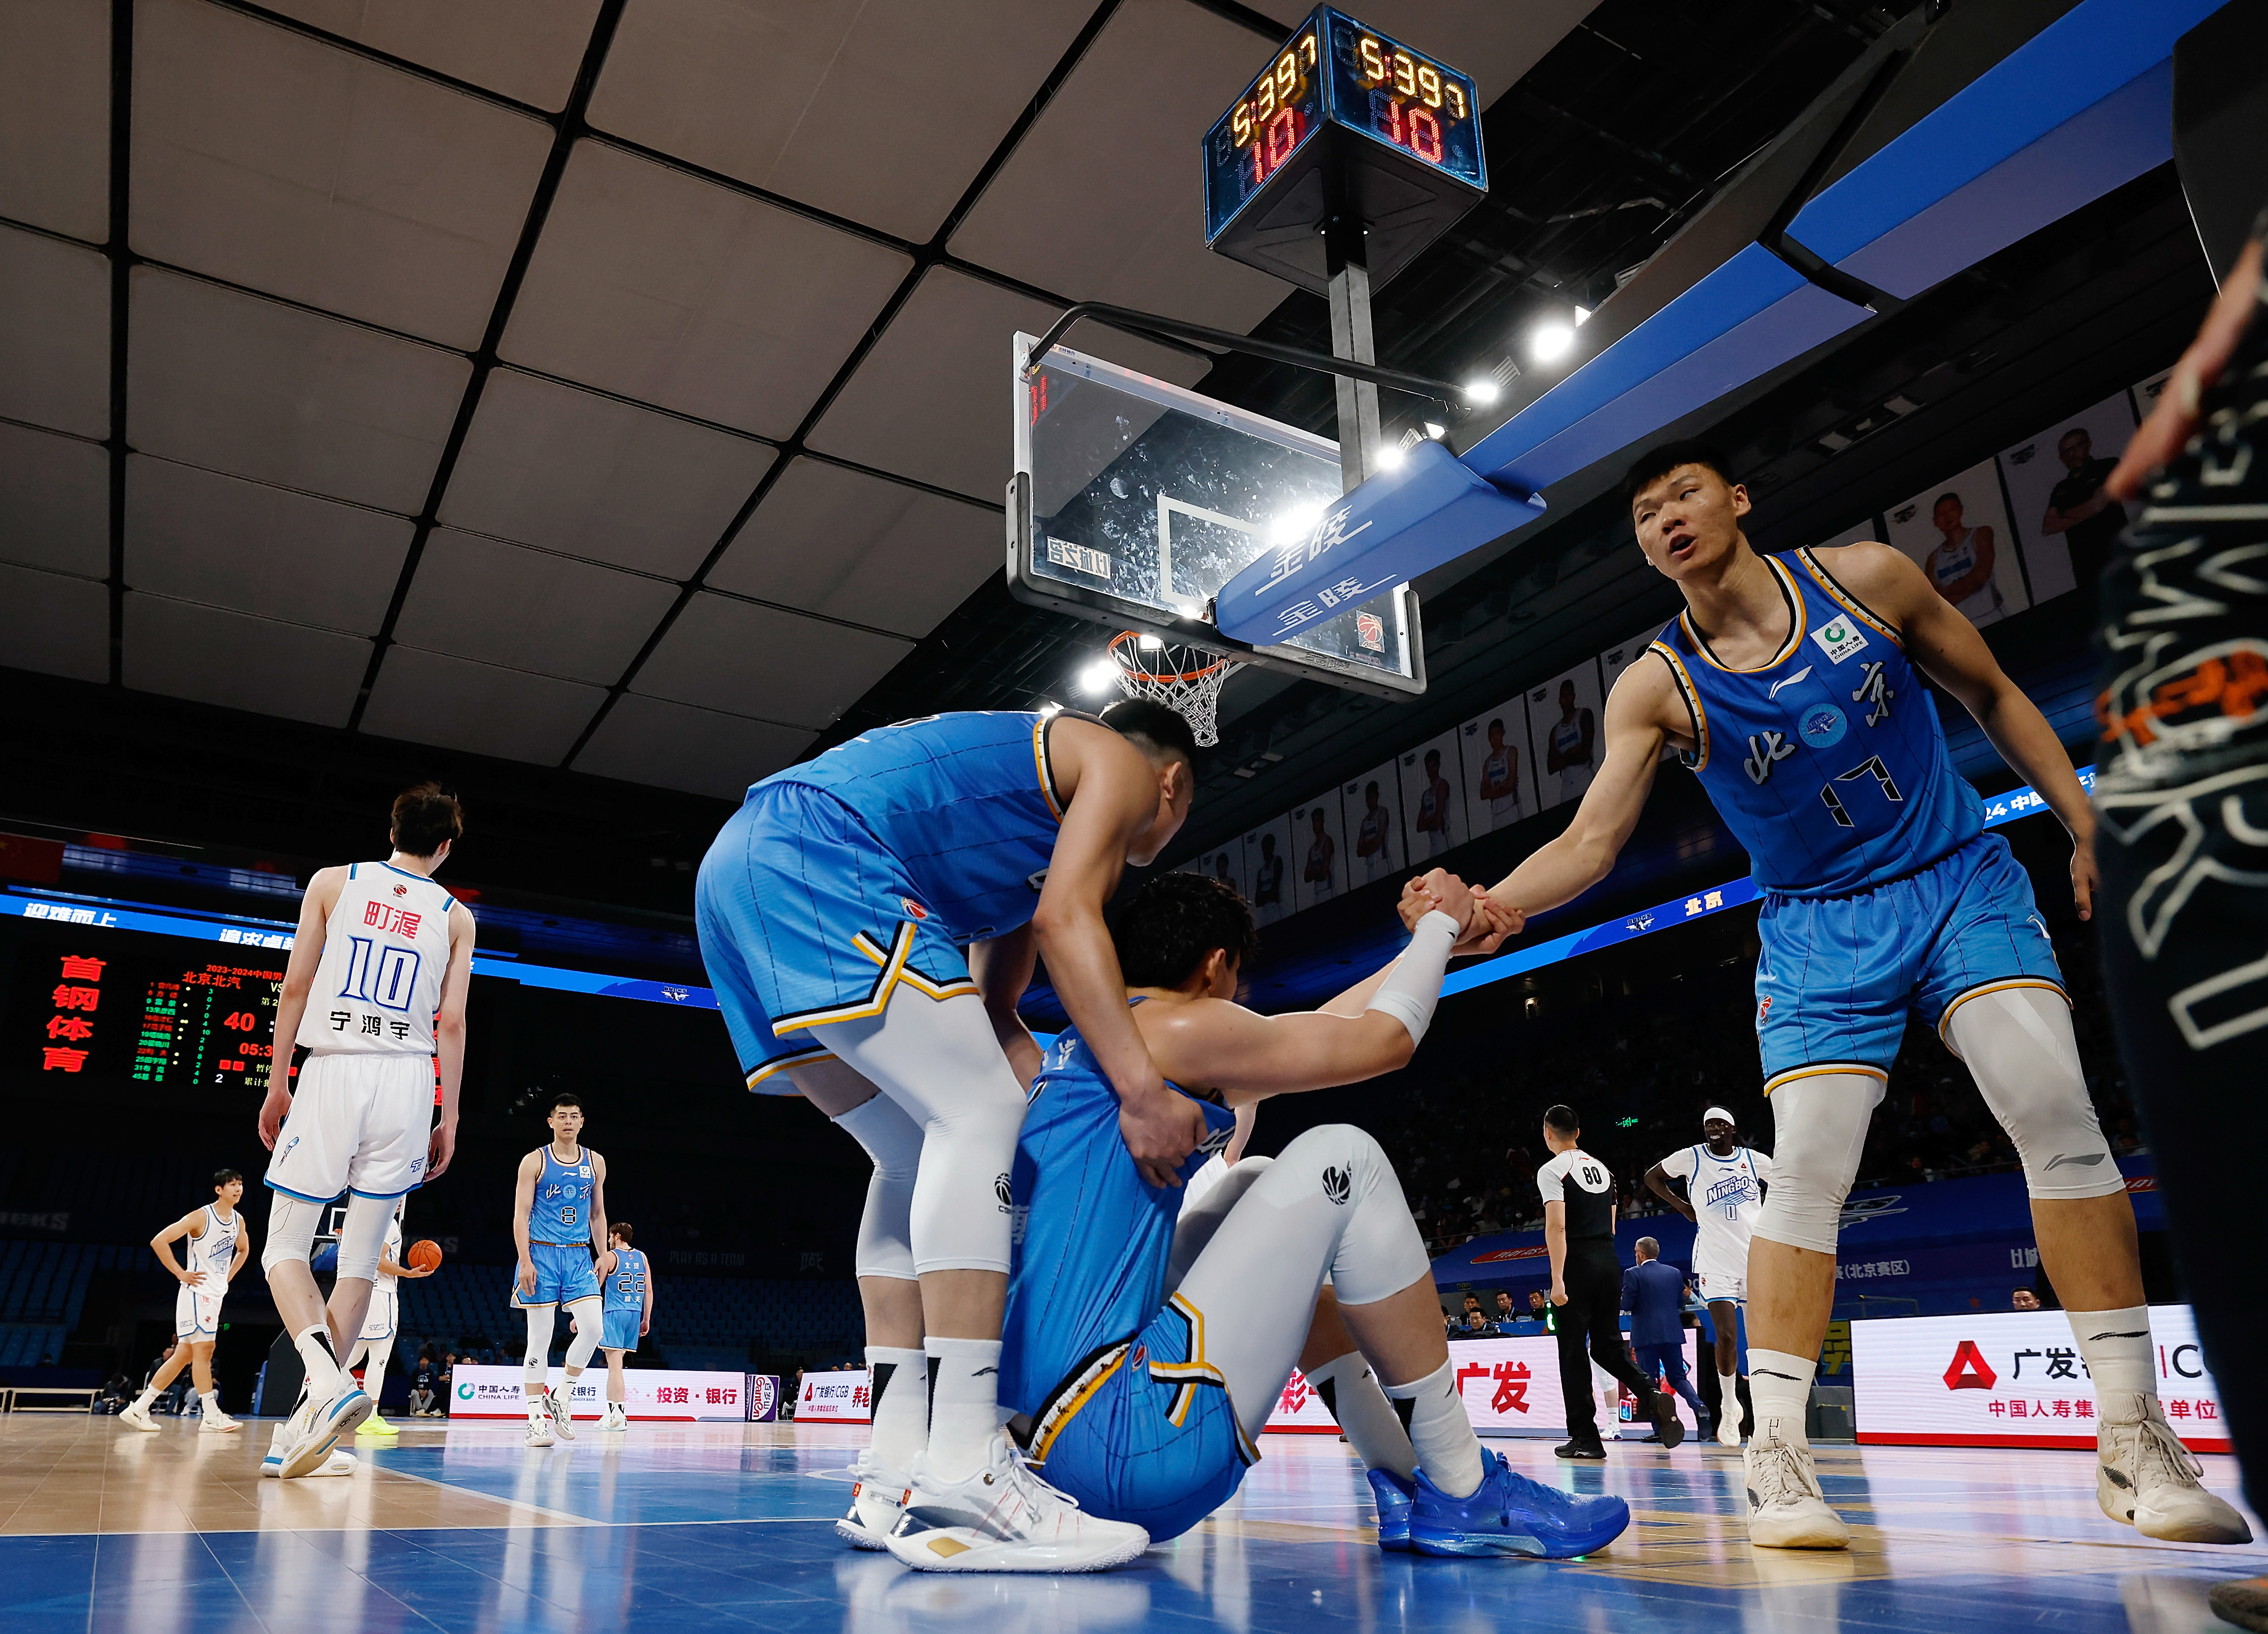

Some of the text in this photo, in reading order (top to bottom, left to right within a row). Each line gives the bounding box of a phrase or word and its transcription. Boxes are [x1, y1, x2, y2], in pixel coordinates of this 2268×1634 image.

[1390, 100, 1442, 163] 10
[1254, 106, 1296, 184] 10
[1830, 636, 1860, 655] 中国人寿
[1835, 640, 1863, 659] CHINA LIFE
[1821, 755, 1903, 828] 17
[1684, 890, 1724, 917] 北京
[23, 903, 117, 928] 迎难而上
[182, 971, 242, 989] 北京北汽
[206, 964, 285, 981] 2023-2024中国男
[336, 934, 422, 1013] 10
[224, 1011, 256, 1031] 40
[239, 1042, 273, 1057] 05:3
[215, 1073, 224, 1083] 2
[1582, 1166, 1602, 1187] 80
[1706, 1176, 1749, 1206] NINGBO
[561, 1206, 577, 1225] 8
[1725, 1203, 1737, 1221] 0
[617, 1272, 645, 1293] 22
[2013, 1348, 2091, 1379] 广发
[479, 1385, 521, 1394] 中国人寿
[763, 1382, 772, 1409] 百岁山
[1457, 1361, 1531, 1415] 广发
